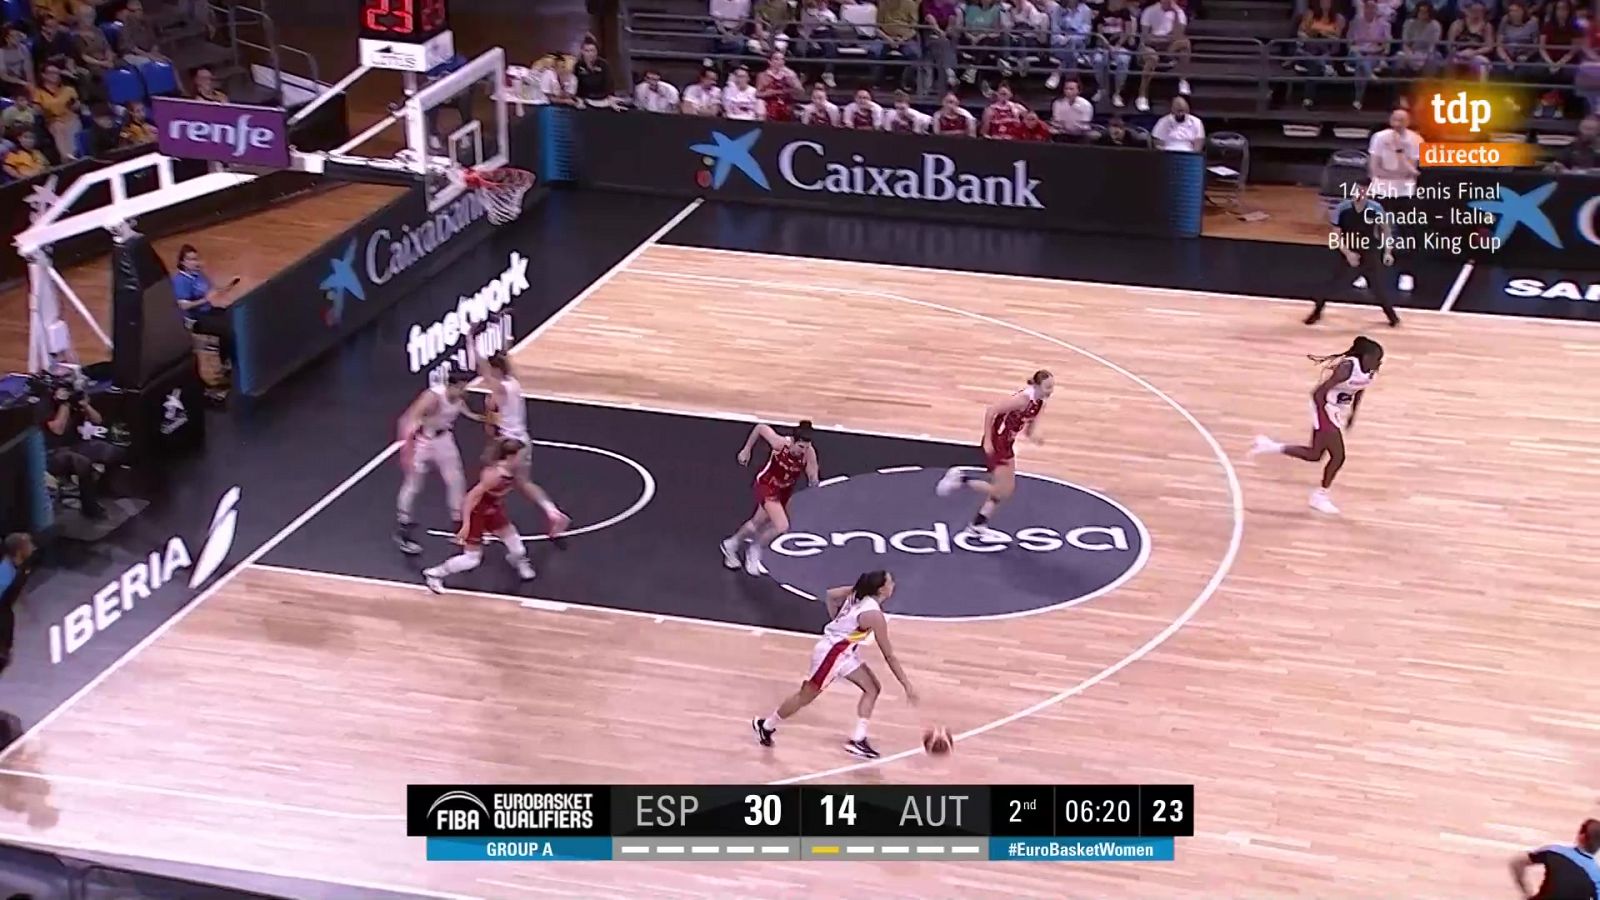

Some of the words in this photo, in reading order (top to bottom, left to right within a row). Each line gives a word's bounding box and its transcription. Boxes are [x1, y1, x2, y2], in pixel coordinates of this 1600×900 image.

[168, 114, 275, 157] renfe
[778, 141, 1046, 209] CaixaBank
[769, 522, 1129, 557] endesa
[49, 536, 192, 664] IBERIA
